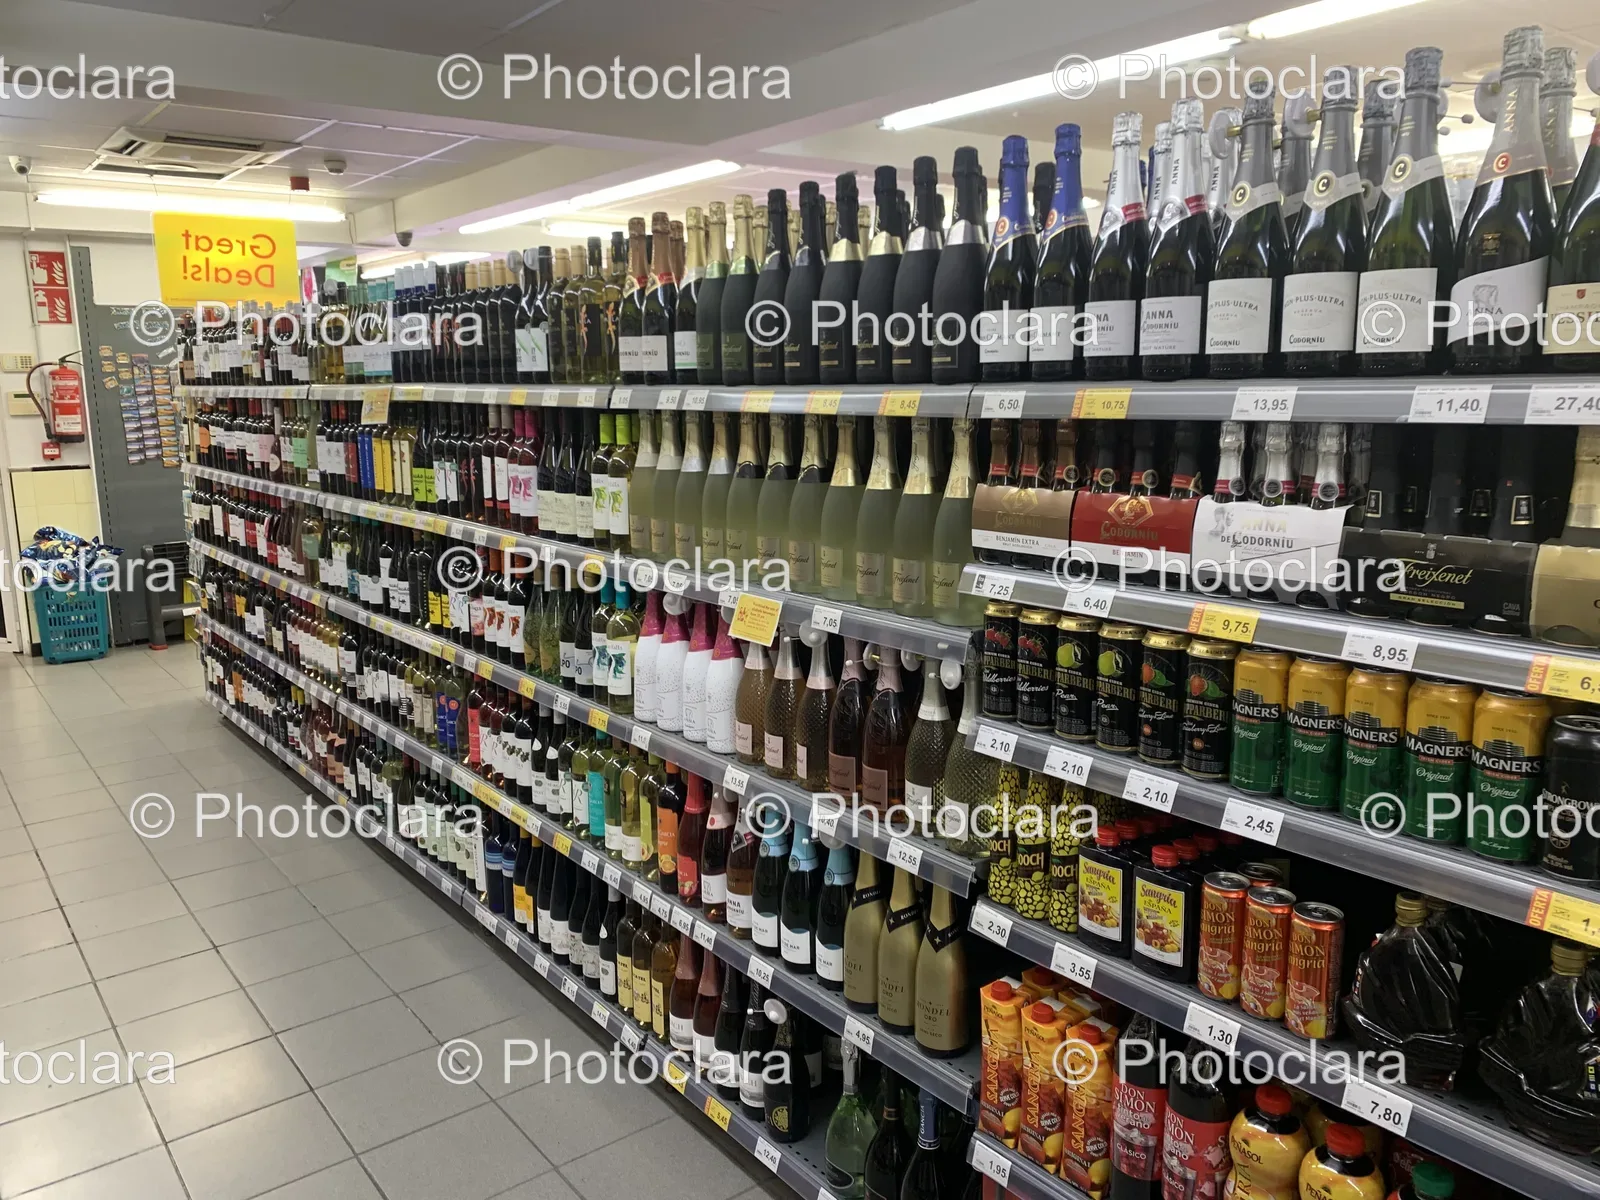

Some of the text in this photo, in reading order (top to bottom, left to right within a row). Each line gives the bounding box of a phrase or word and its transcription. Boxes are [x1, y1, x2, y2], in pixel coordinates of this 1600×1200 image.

[1146, 310, 1173, 321] ANNA
[900, 399, 917, 409] 8,45
[1385, 558, 1474, 587] Freixenet
[988, 583, 1010, 597] 7,25
[1083, 597, 1107, 611] 6,40
[1221, 619, 1250, 635] 9,75
[1372, 644, 1407, 662] 8,95
[1286, 710, 1344, 730] MAGNERS
[1233, 725, 1260, 740] Original
[990, 739, 1011, 753] 2,10
[1294, 738, 1326, 754] Original
[1405, 735, 1472, 757] MAGNERS
[1346, 749, 1378, 767] Original
[1472, 749, 1541, 773] MAGNERS
[1060, 760, 1085, 777] 2,10
[1415, 767, 1453, 783] Original
[1142, 788, 1168, 805] 2,10
[1480, 781, 1521, 799] Original
[1244, 815, 1274, 834] 2,45
[898, 851, 917, 866] 12,55
[1530, 889, 1551, 928] OFERTA
[987, 920, 1007, 939] 2,30
[1250, 918, 1271, 928] DON
[1292, 933, 1312, 943] DON
[755, 967, 770, 983] 10,25
[1069, 963, 1091, 981] 3,55
[923, 1014, 937, 1023] ORO
[855, 1030, 872, 1046] 4,95
[1207, 1024, 1233, 1045] 1,30
[1121, 1083, 1145, 1100] DON
[1114, 1088, 1156, 1113] SIMON
[1369, 1100, 1402, 1126] 7,80
[989, 1160, 1007, 1178] 1,95
